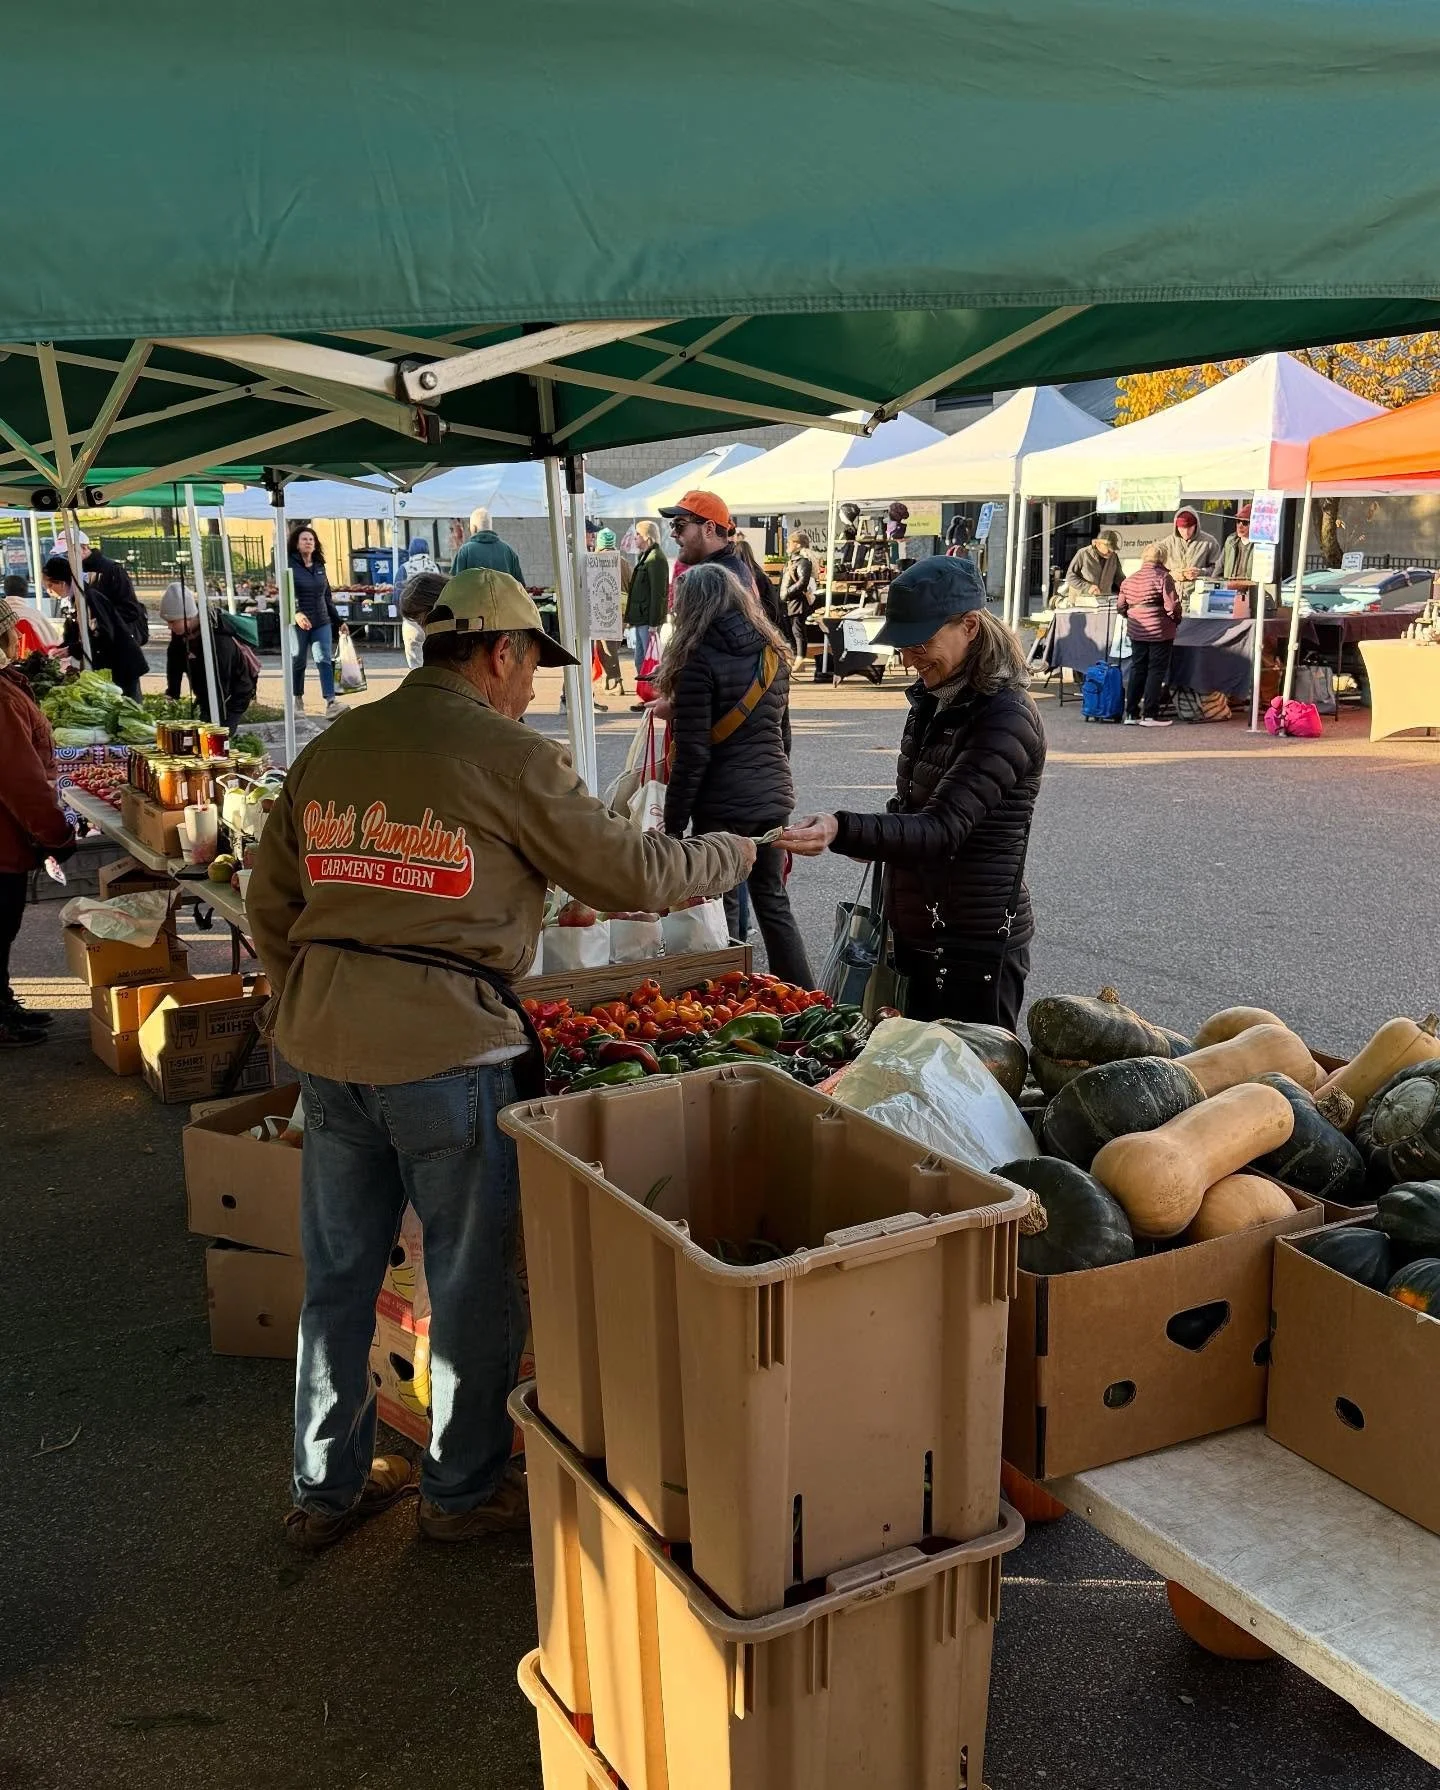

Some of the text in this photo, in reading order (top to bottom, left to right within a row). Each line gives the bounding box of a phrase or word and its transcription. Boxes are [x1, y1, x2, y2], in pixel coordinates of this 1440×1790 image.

[304, 801, 467, 864] Peter's Pumpkins
[321, 859, 435, 889] CARMEN'S CORN
[168, 1056, 204, 1068] T-SHIRT
